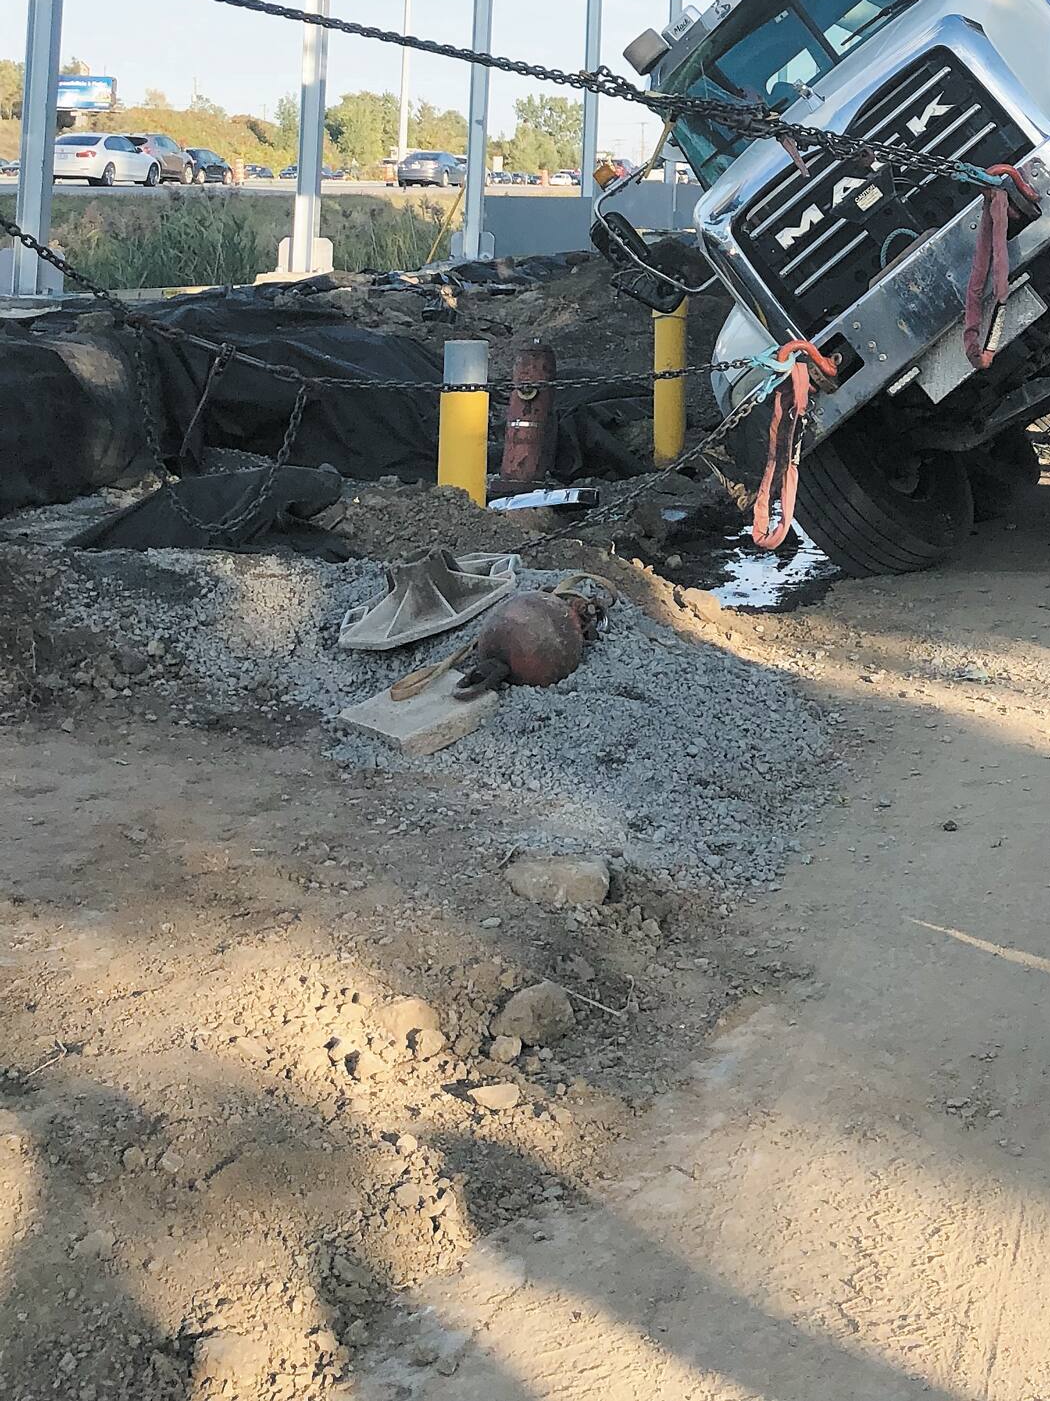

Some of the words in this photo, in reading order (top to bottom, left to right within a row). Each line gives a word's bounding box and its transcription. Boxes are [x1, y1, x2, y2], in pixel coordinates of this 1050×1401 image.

[673, 18, 691, 36] Mack
[774, 90, 957, 250] MAK
[854, 183, 877, 203] CAUTION
